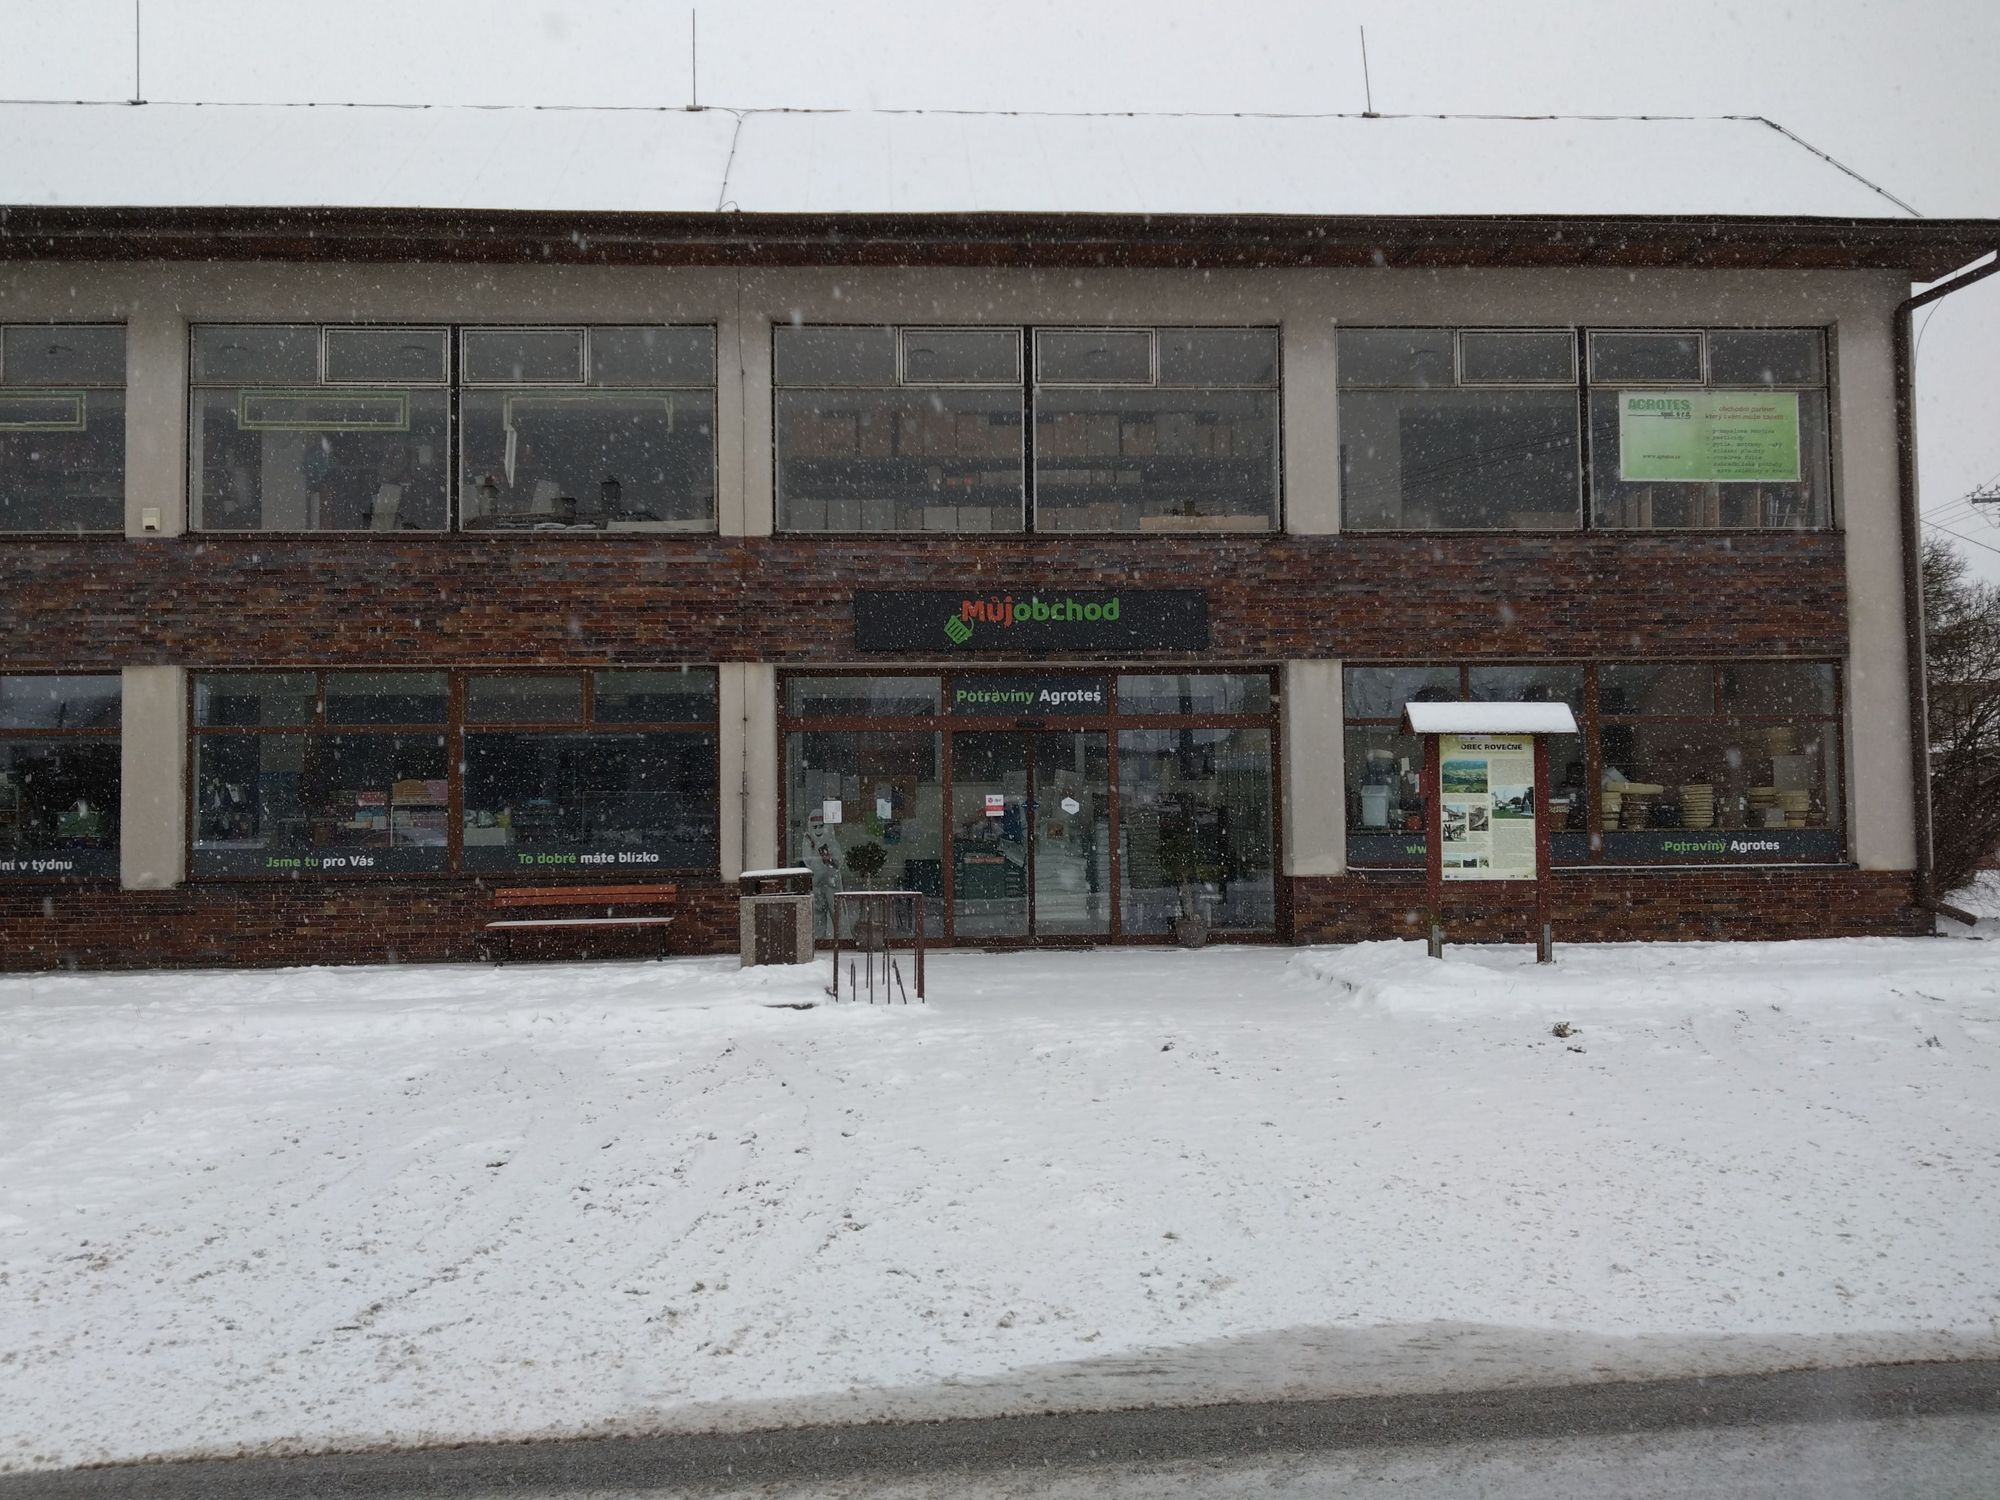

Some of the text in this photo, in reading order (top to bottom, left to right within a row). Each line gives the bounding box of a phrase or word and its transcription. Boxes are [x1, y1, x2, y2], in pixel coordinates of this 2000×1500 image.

[956, 688, 1101, 705] Potraviny Agrotes
[1460, 743, 1482, 751] OBEC
[1664, 840, 1780, 853] Potraviny Agrotes
[266, 855, 374, 869] Jsme tu pro Vás
[518, 851, 660, 864] To dobré máte blízko
[19, 861, 28, 870] v
[32, 858, 73, 873] týdnu
